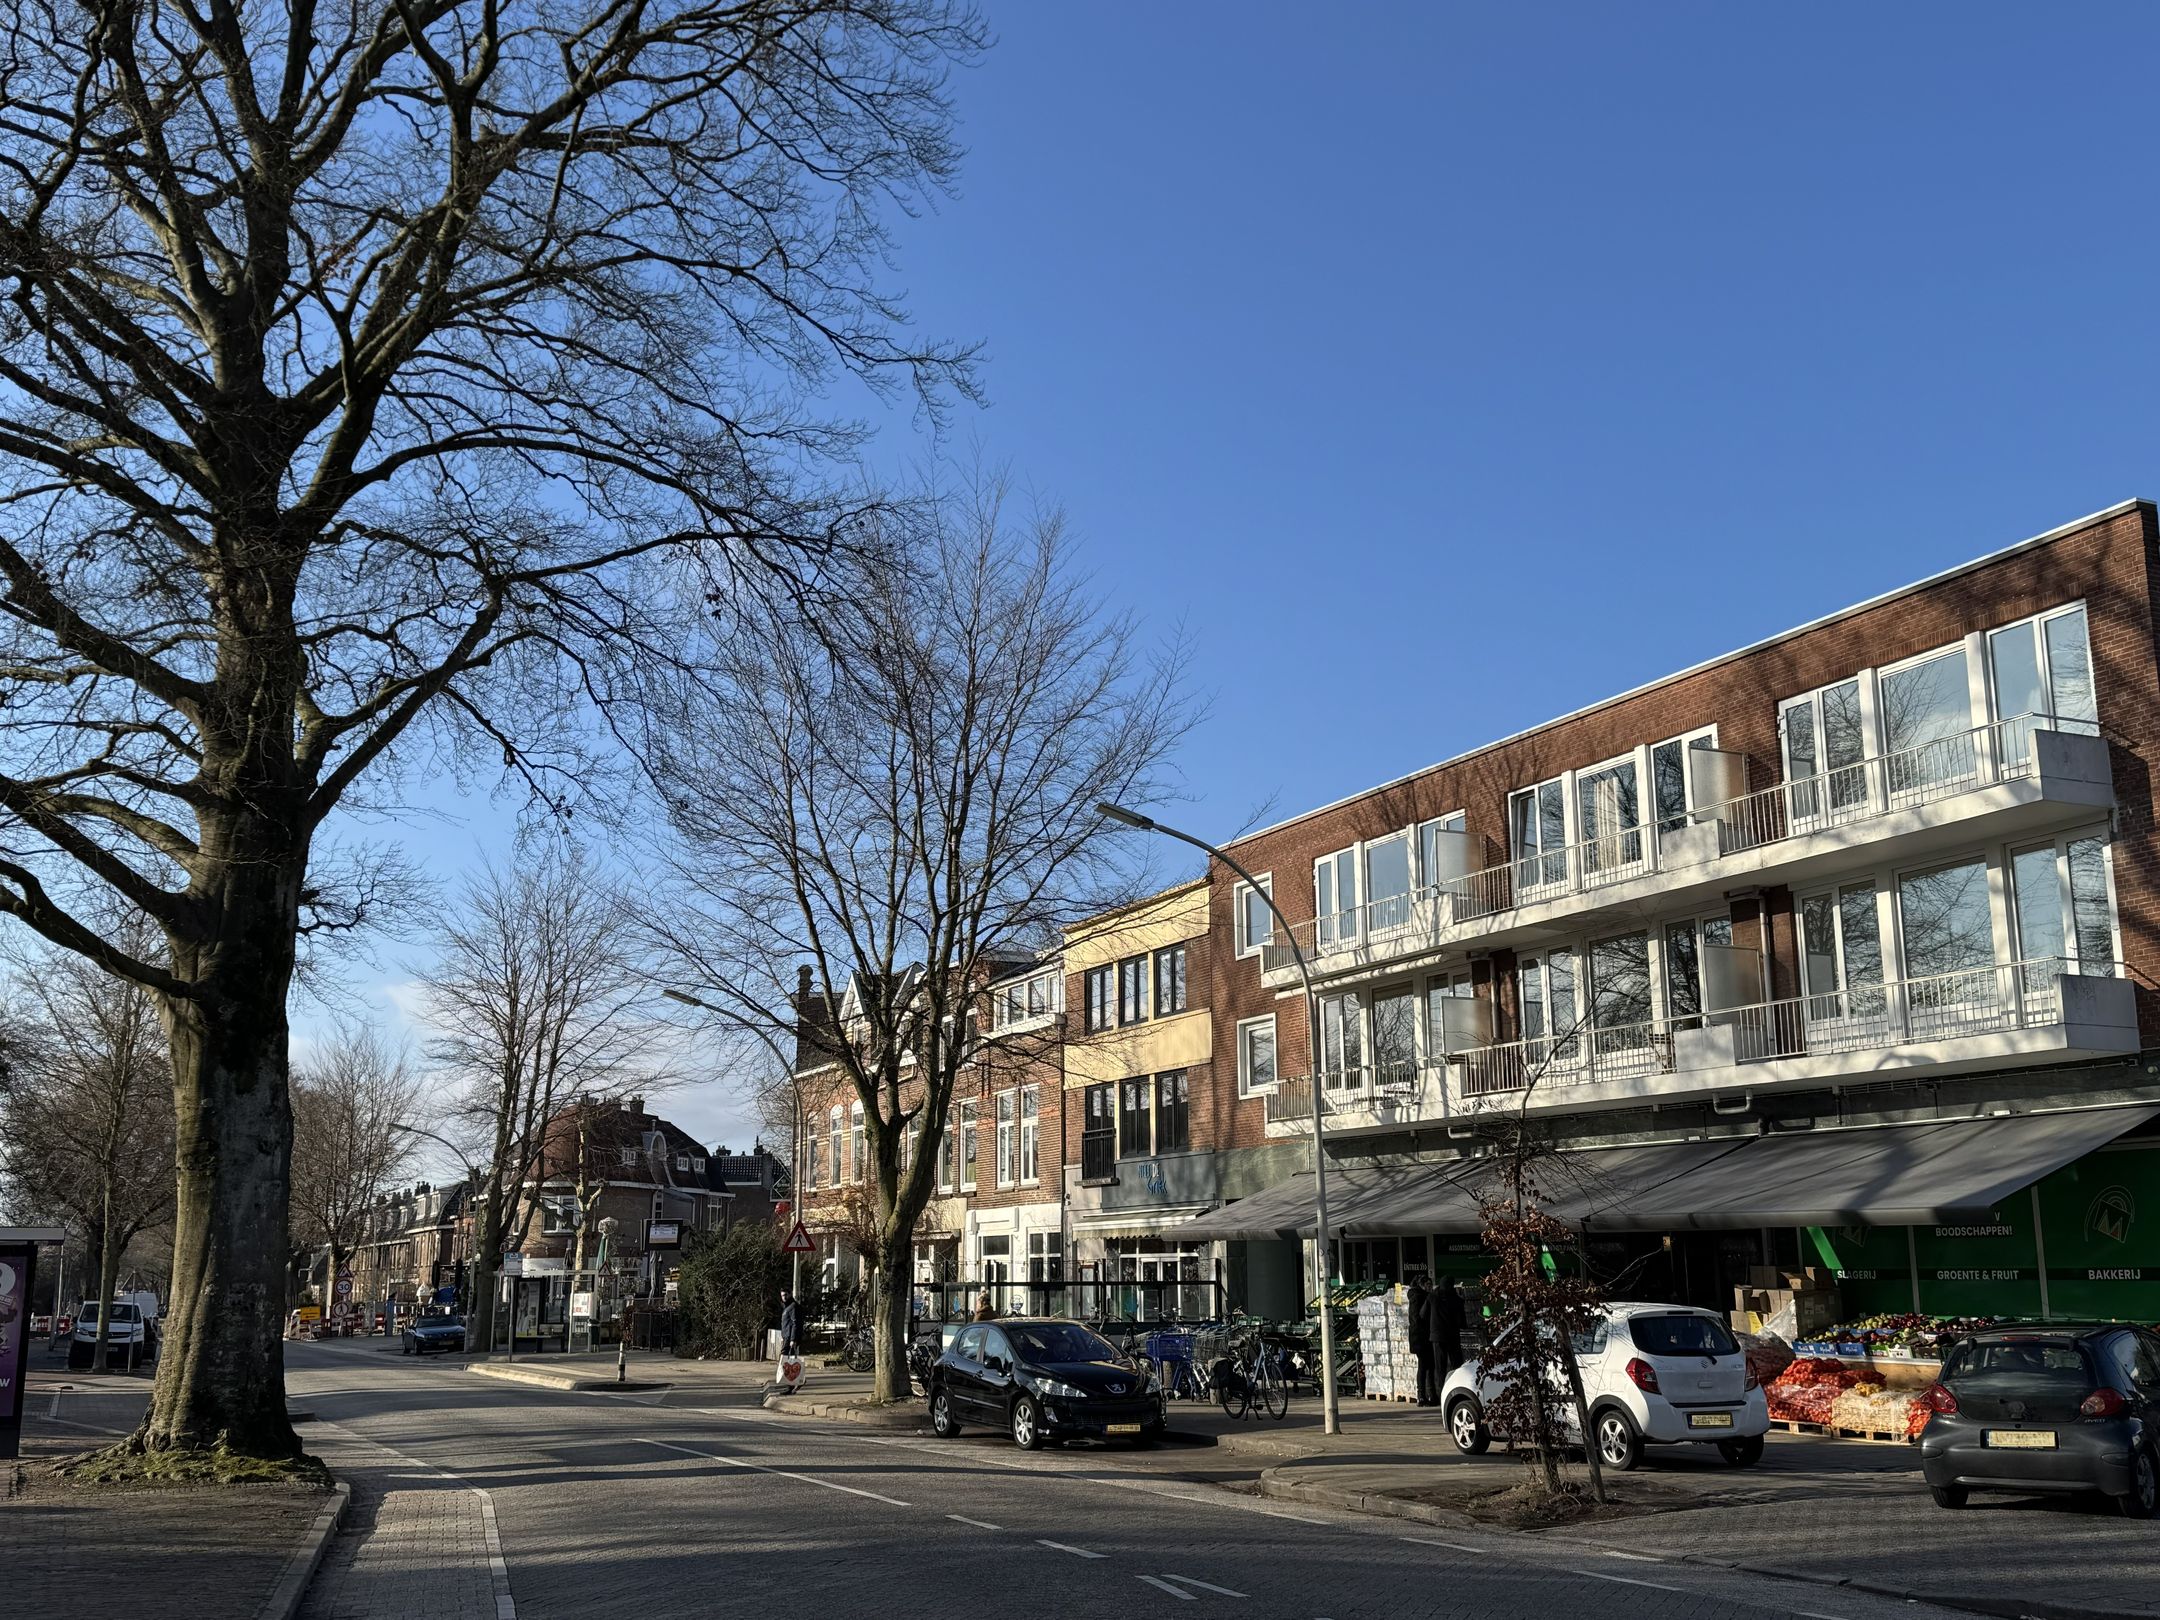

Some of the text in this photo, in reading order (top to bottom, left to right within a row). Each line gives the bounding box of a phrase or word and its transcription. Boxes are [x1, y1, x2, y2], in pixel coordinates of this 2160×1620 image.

[1935, 1225, 2013, 1237] BOODSCHAPPEN!
[1837, 1269, 1877, 1280] SLAGERIJ
[1936, 1269, 2019, 1280] GROENTE & FRUIT
[2088, 1269, 2141, 1280] BAKKERIJ
[338, 1283, 350, 1291] 30
